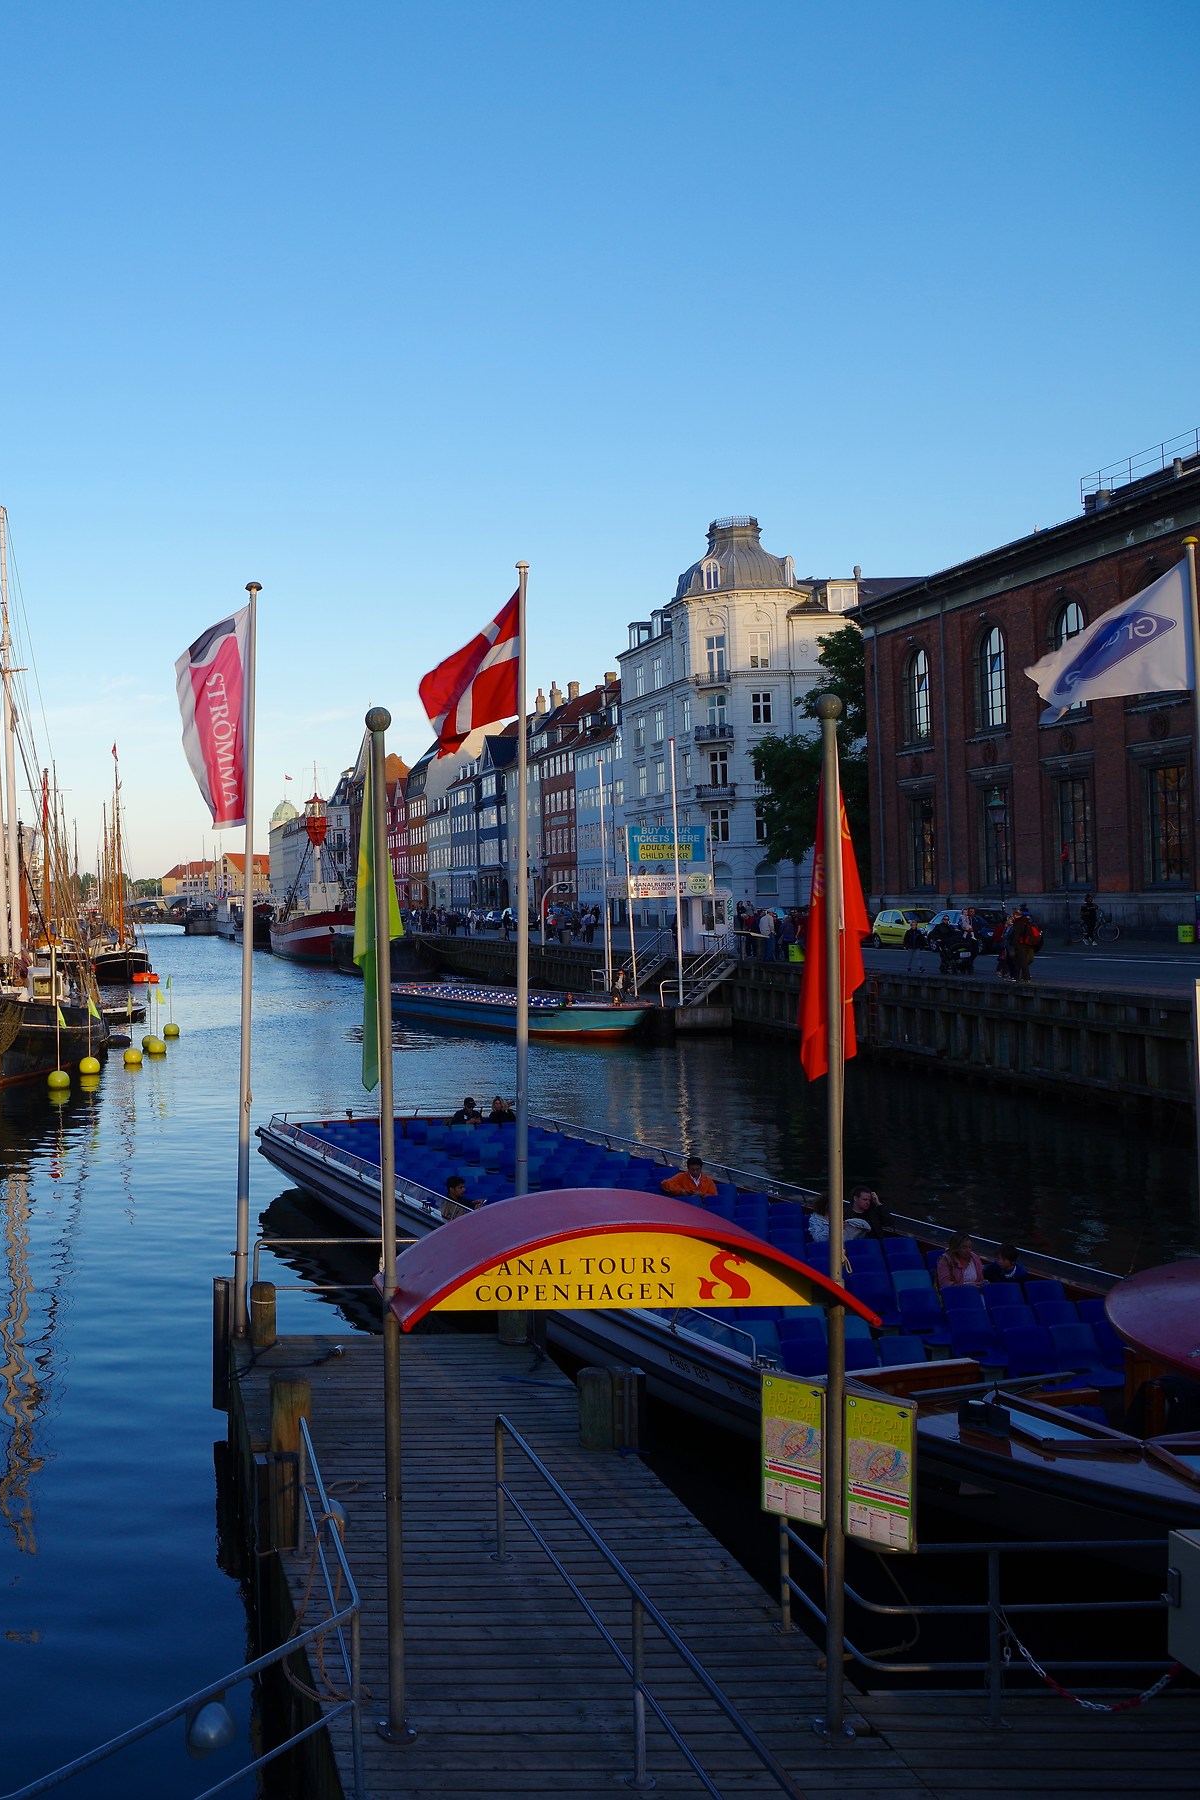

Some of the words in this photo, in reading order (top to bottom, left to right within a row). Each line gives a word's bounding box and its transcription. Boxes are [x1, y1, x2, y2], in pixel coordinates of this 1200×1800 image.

[206, 672, 239, 808] STRÖMMA
[632, 835, 670, 843] TICKETS
[641, 827, 661, 835] BUY
[481, 1258, 571, 1276] ANAL
[580, 1257, 671, 1274] TOURS
[475, 1283, 675, 1302] COPENHAGEN
[669, 1353, 691, 1373] Pass
[769, 1390, 795, 1406] HOP
[798, 1397, 816, 1410] ON
[767, 1401, 793, 1414] HOP
[797, 1410, 819, 1422] OFF
[853, 1411, 881, 1426] HOP
[884, 1418, 906, 1431] ON
[852, 1422, 880, 1437] HOP
[883, 1430, 907, 1445] OFF
